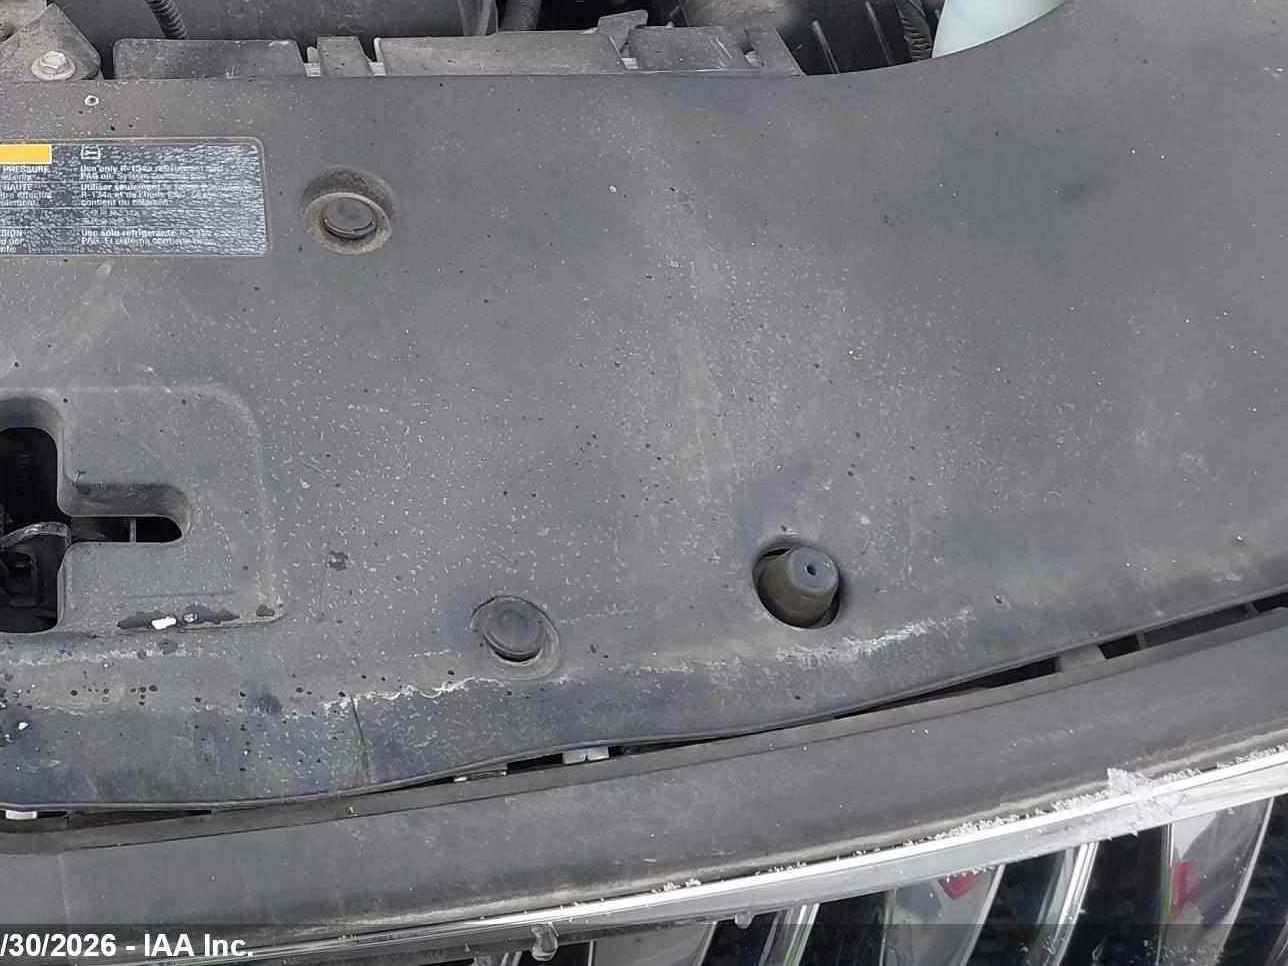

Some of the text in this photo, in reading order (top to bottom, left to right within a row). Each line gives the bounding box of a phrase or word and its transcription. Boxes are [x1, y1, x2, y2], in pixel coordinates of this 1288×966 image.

[2, 165, 50, 173] PRESSURE
[80, 165, 97, 173] Use
[98, 165, 118, 174] only
[80, 199, 116, 207] contient
[81, 229, 98, 237] Use
[122, 229, 175, 238] refrigerante
